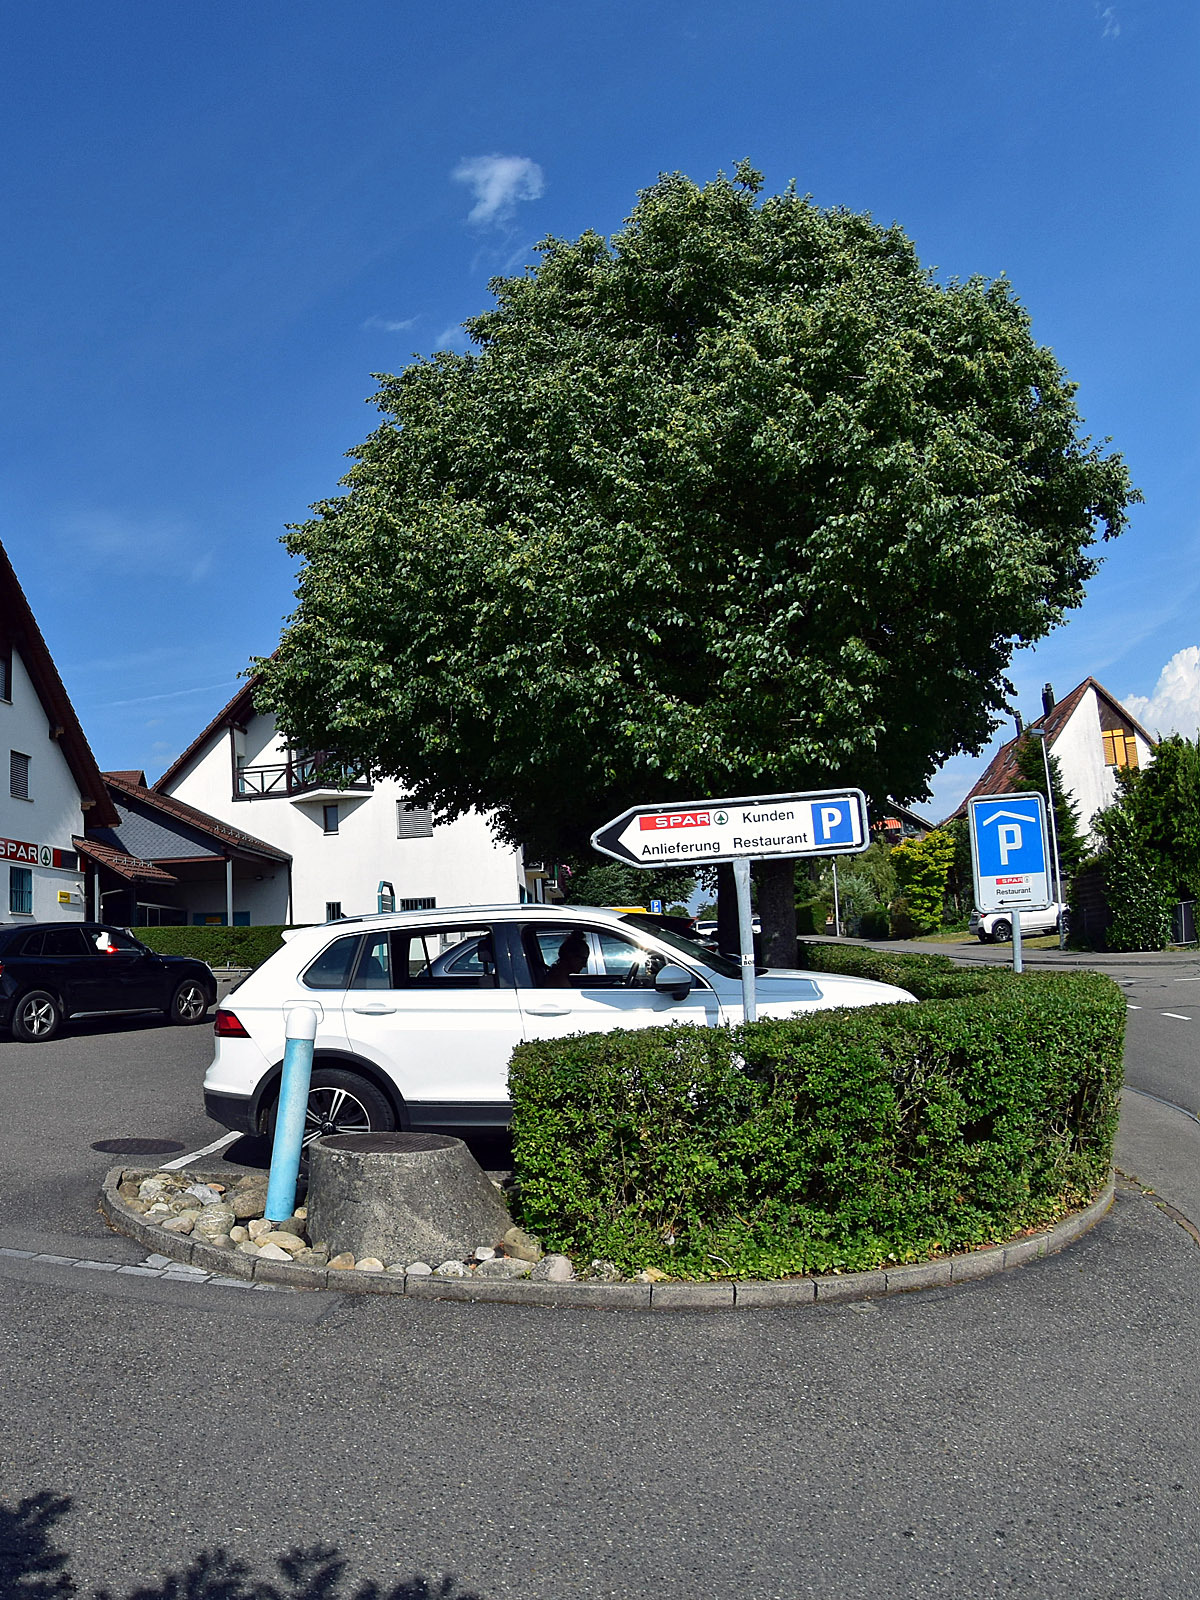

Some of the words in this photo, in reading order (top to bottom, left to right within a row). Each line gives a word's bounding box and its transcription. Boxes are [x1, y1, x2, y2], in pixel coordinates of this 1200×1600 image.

[655, 814, 709, 828] SPAR
[742, 810, 795, 824] Kunden
[820, 807, 842, 839] P
[641, 840, 721, 856] Anlieferung
[734, 832, 808, 849] Restaurant
[997, 823, 1023, 866] P
[1001, 876, 1024, 884] SPAR
[996, 887, 1032, 896] Restaurant
